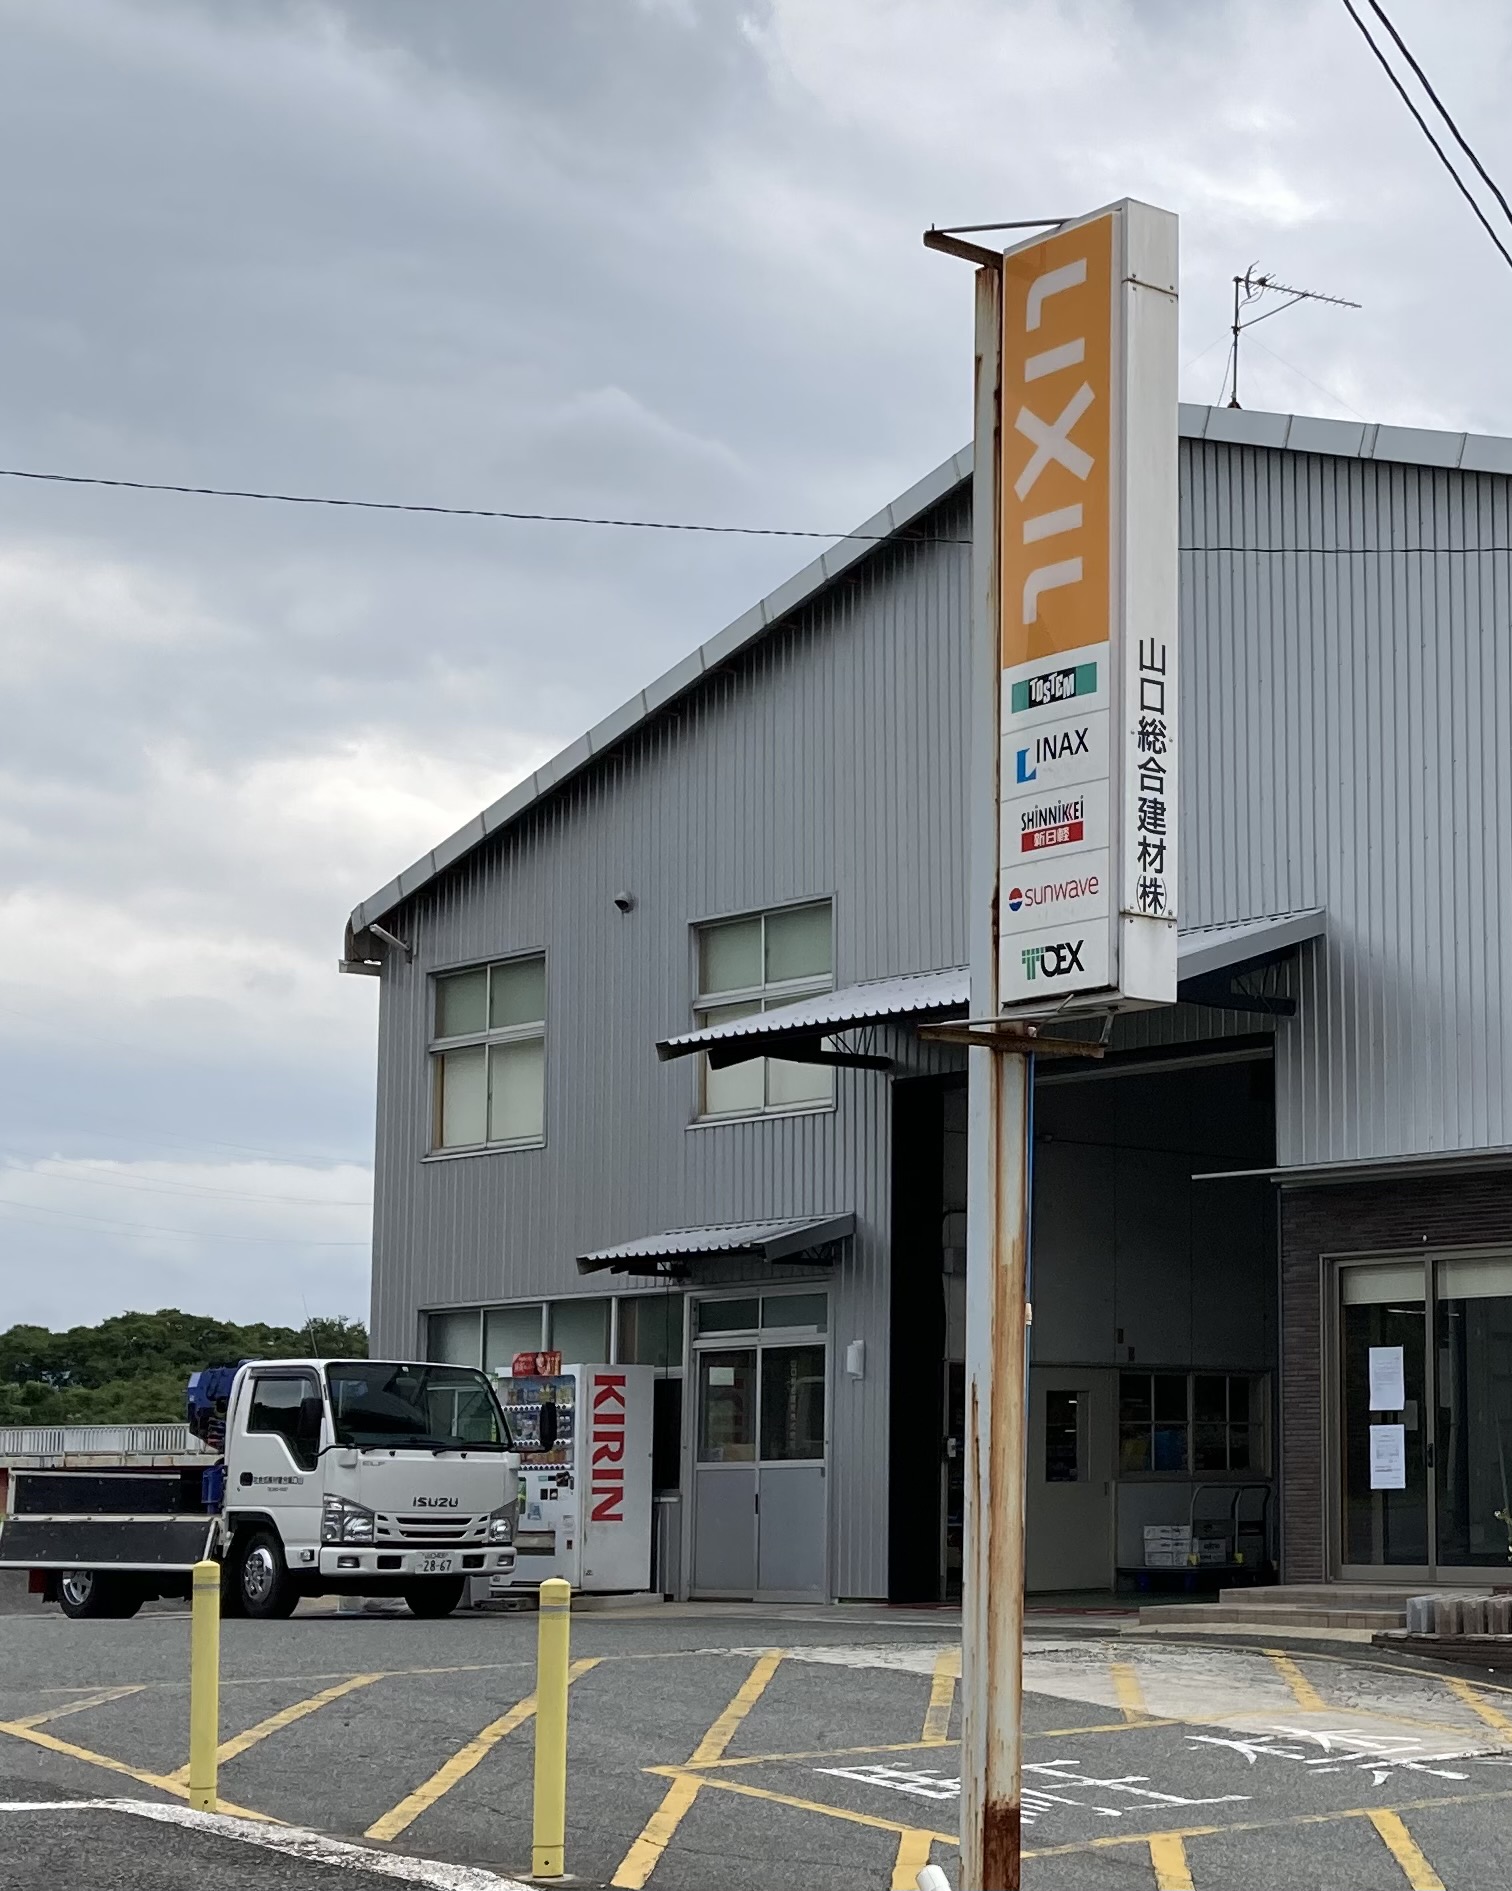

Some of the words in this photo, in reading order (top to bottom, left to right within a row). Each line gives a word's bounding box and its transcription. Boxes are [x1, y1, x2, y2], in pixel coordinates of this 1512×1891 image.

[1014, 257, 1096, 625] LIXIL
[1029, 672, 1075, 703] TOSTEM
[1024, 876, 1099, 906] sunwave
[1021, 940, 1085, 980] TOEX
[591, 1374, 627, 1522] KIRIN
[412, 1497, 459, 1508] ISUZU
[423, 1559, 452, 1572] 28-67
